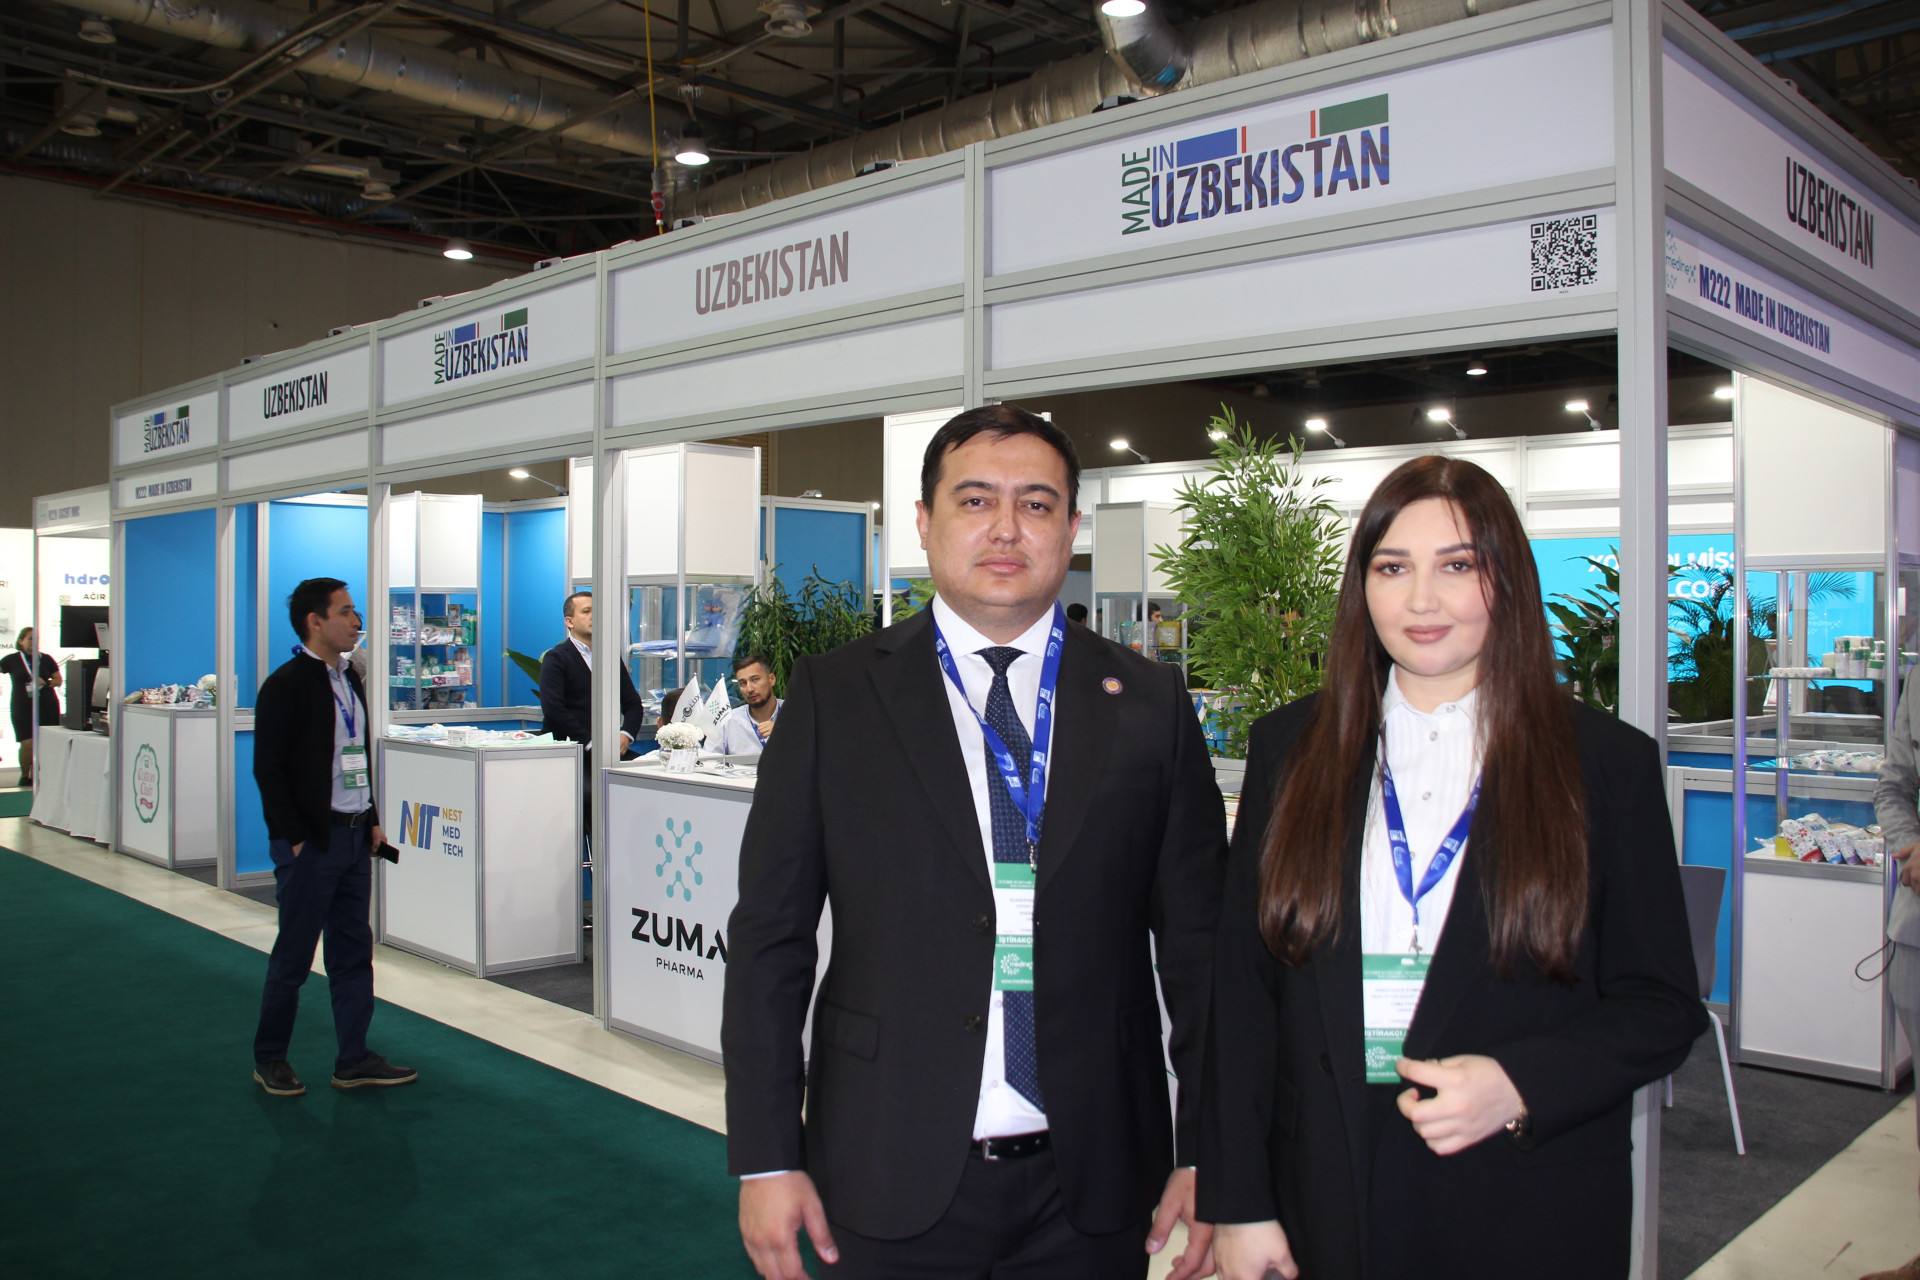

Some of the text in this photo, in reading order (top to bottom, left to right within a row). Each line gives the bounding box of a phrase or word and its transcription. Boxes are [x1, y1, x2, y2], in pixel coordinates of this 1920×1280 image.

[1152, 126, 1389, 228] UZBEKISTAN
[1153, 142, 1174, 173] IN
[1122, 147, 1150, 236] MADE
[1786, 156, 1873, 270] UZBEKISTAN
[696, 231, 849, 315] UZBEKISTAN
[1699, 264, 1830, 355] M222 MADE IN UZBEKISTAN
[434, 332, 446, 385] MADE
[445, 326, 528, 381] UZBEKISTAN
[263, 371, 328, 419] UZBEKISTAN
[150, 418, 190, 451] UZBEKISTAN
[442, 807, 463, 823] NEST
[442, 824, 461, 840] MED
[442, 842, 464, 858] TECH
[656, 957, 705, 981] PHARMA
